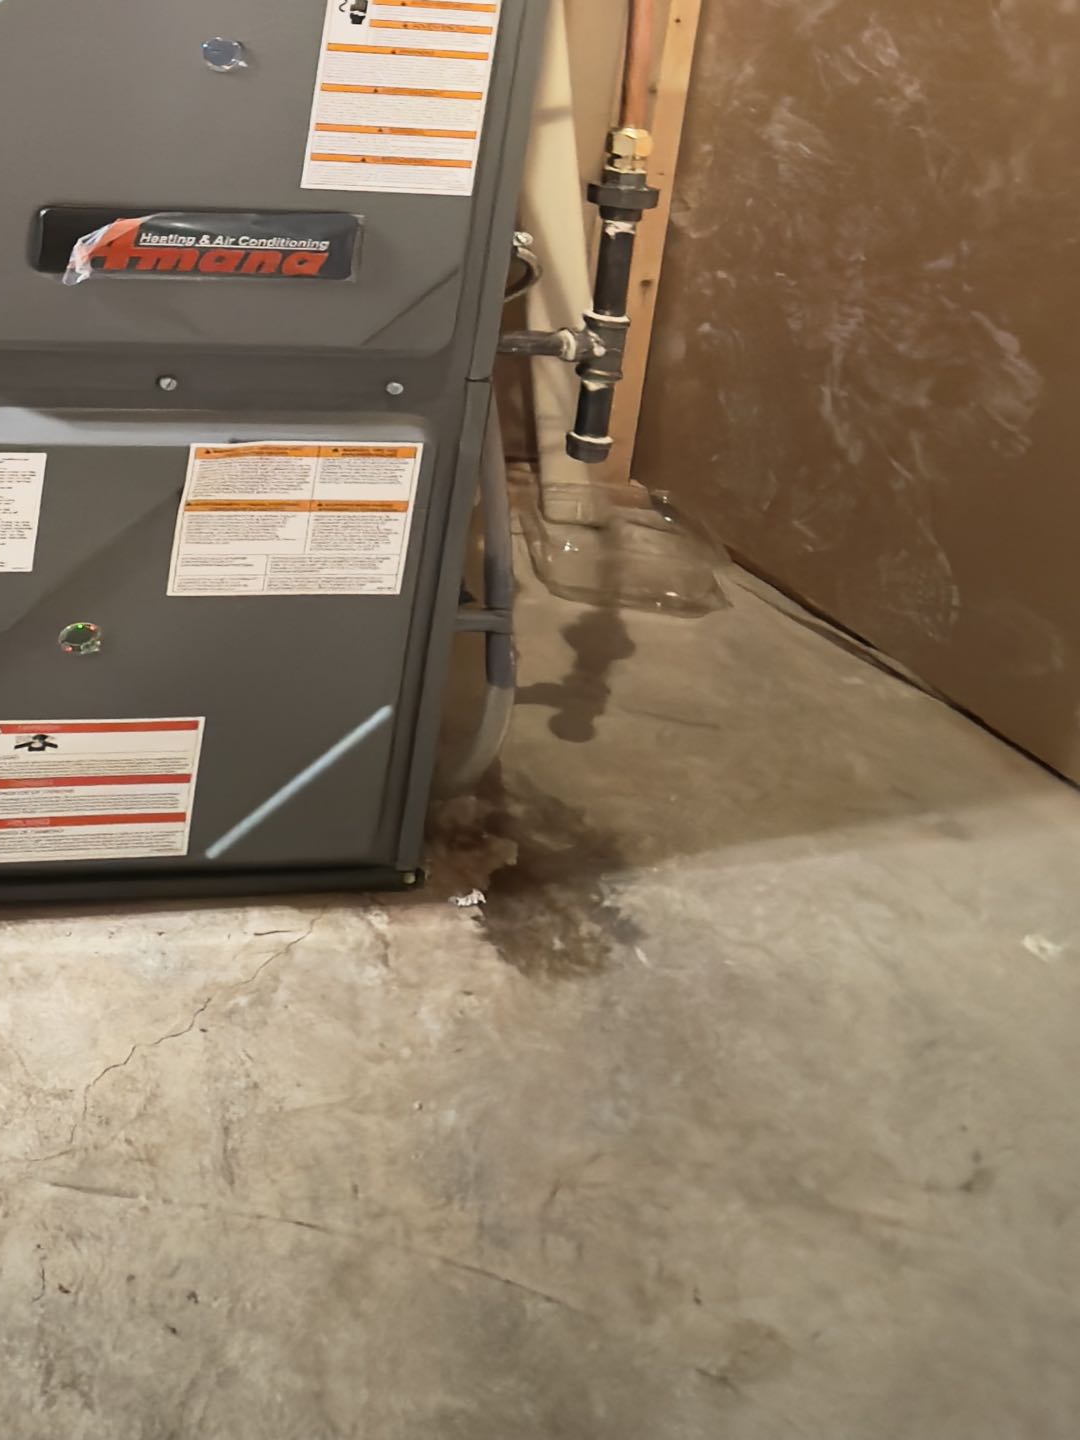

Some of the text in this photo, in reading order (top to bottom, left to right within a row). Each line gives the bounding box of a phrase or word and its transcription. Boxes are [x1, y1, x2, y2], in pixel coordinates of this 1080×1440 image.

[84, 218, 329, 277] Amana
[139, 233, 330, 250] Heating & Air Conditioning
